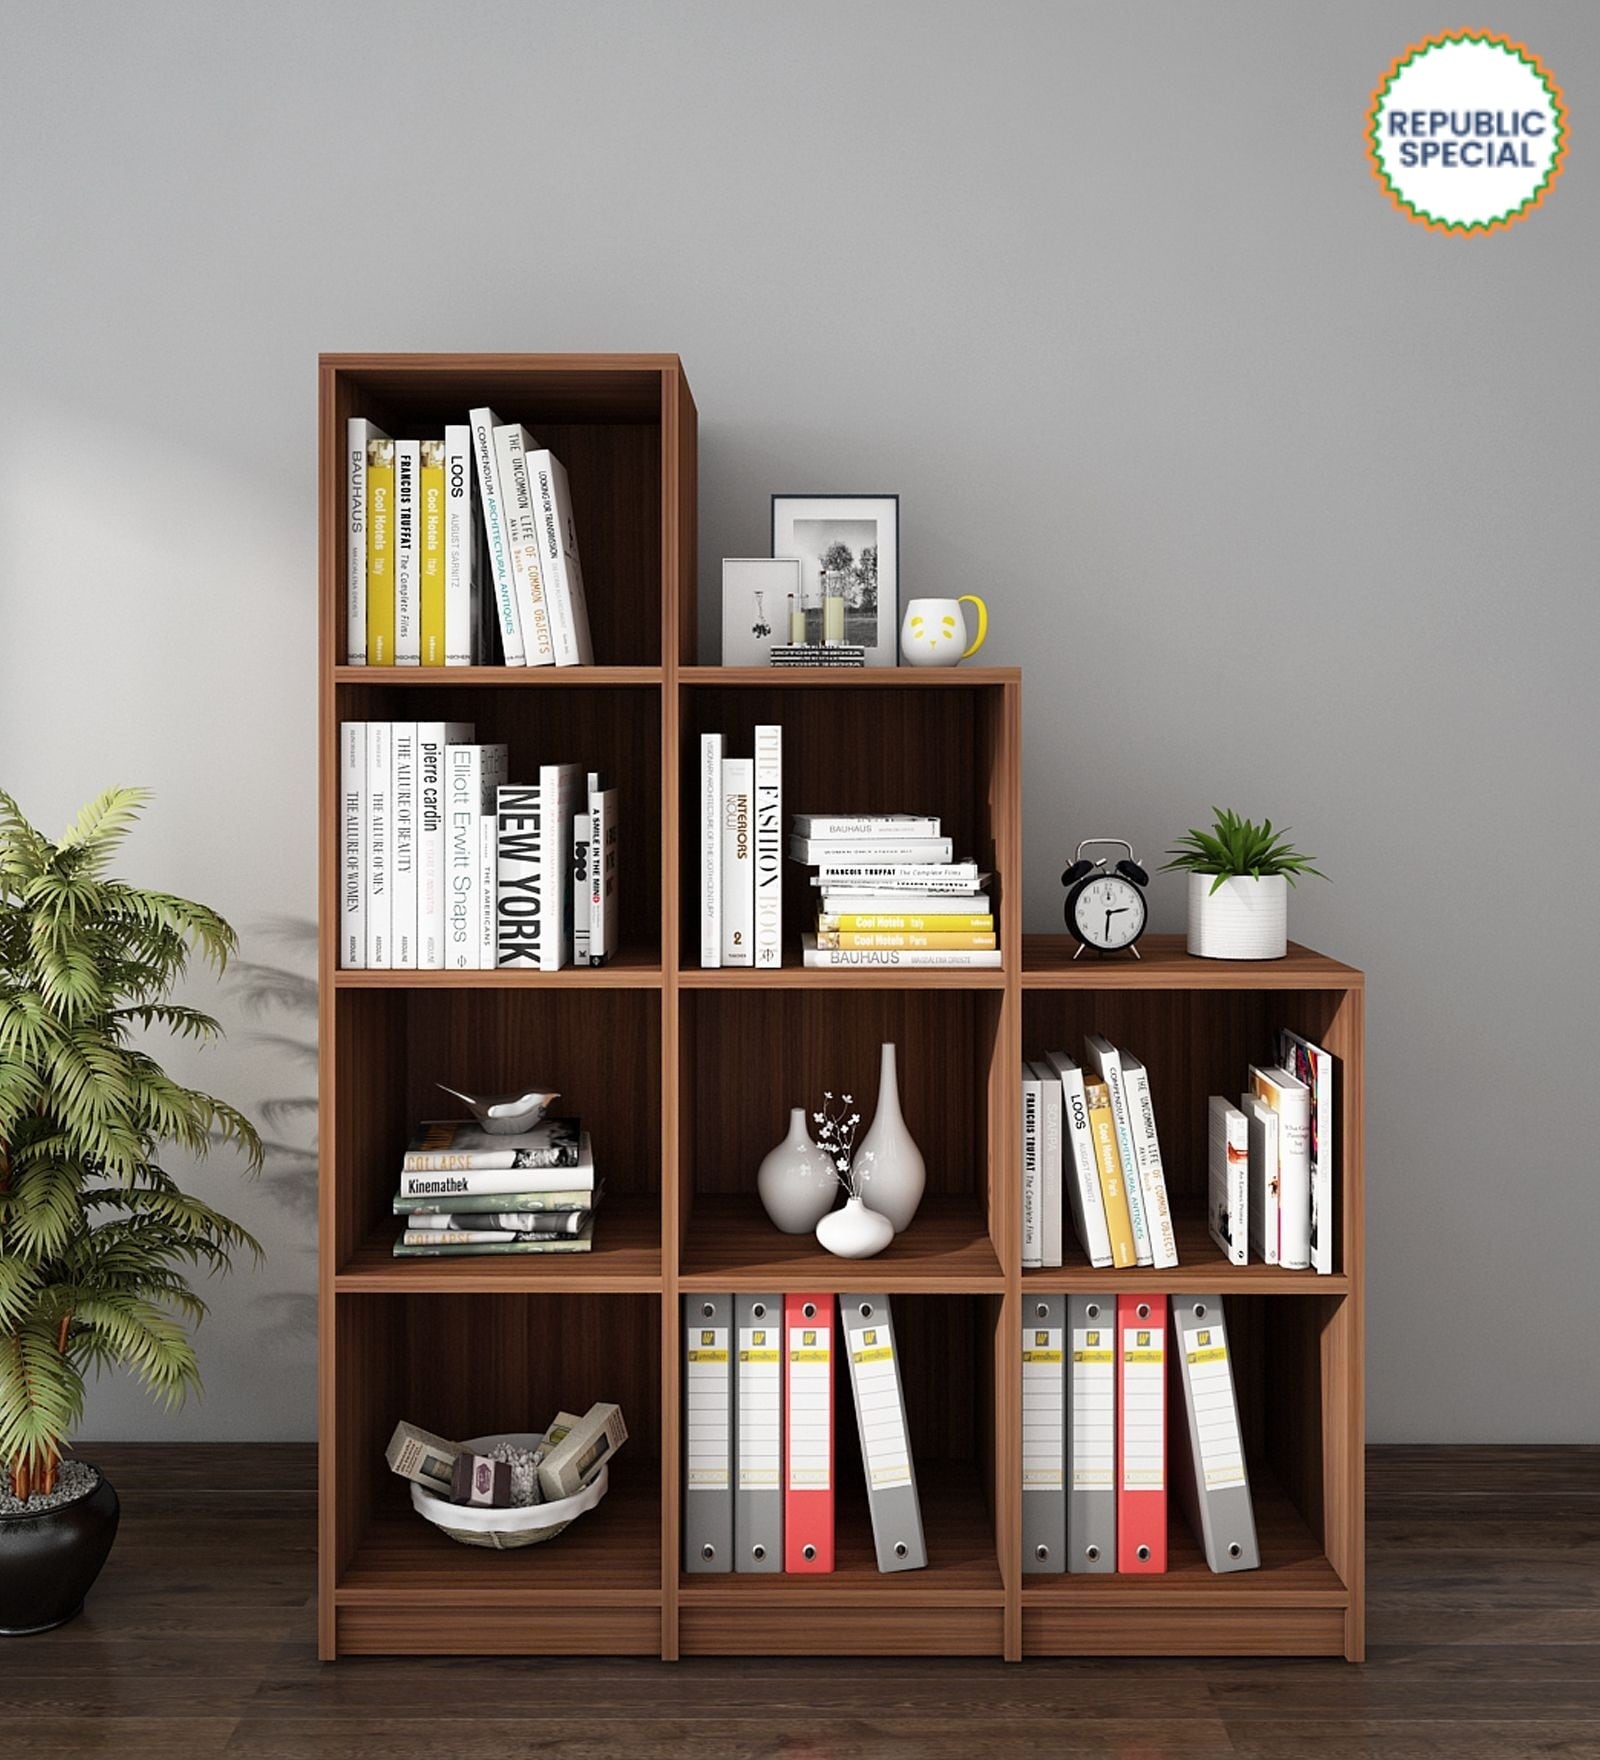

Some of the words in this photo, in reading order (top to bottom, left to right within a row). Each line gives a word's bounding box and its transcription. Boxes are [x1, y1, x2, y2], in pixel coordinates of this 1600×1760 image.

[508, 434, 521, 452] THE
[400, 454, 412, 504] FRANCOIS
[450, 455, 463, 498] LOOS
[512, 458, 528, 509] UNCOMMON
[538, 470, 551, 499] LOOKING
[352, 451, 362, 533] BAUHAUS
[374, 488, 386, 512] Cool
[427, 488, 438, 512] Cool
[542, 500, 552, 512] FOR
[374, 514, 386, 550] Hotels
[400, 508, 412, 550] TRUFFAT
[427, 514, 438, 550] Hotels
[450, 513, 460, 549] AUGUST
[477, 426, 494, 495] COMPENDIUM
[488, 498, 507, 580] ARCHITECTURAL
[500, 584, 515, 635] ANTIQUES
[510, 518, 519, 542] Akiko
[520, 515, 533, 540] LIFE
[373, 558, 385, 576] Italy
[400, 554, 410, 570] The
[426, 558, 438, 576] Italy
[524, 546, 536, 559] OF
[450, 551, 460, 588] SARNITZ
[400, 572, 410, 612] Complete
[528, 565, 541, 604] COMMON
[400, 614, 410, 638] Films
[534, 610, 550, 654] OBJECTS
[398, 736, 411, 760] THE
[759, 729, 778, 778] THE
[421, 743, 442, 783] pierre
[453, 751, 471, 804] Elliott
[398, 762, 411, 807] ALLURE
[347, 792, 358, 812] THE
[373, 792, 384, 812] THE
[424, 788, 442, 832] cardin
[398, 809, 411, 825] OF
[499, 789, 541, 862] NEW
[592, 817, 600, 845] SMILE
[738, 794, 747, 860] INTERIORS
[829, 824, 872, 834] BAUHAUS
[347, 814, 358, 854] ALLURE
[373, 815, 384, 854] ALLURE
[453, 812, 471, 868] Erwitt
[707, 831, 714, 841] OF
[759, 786, 778, 888] FASHION
[347, 856, 358, 870] OF
[373, 856, 384, 870] OF
[398, 827, 411, 874] BEAUTY
[592, 847, 600, 857] IN
[592, 860, 600, 876] THE
[347, 872, 358, 913] WOMEN
[373, 872, 384, 896] MEN
[592, 878, 600, 904] MIND
[450, 876, 472, 943] Snaps
[499, 874, 541, 964] YORK
[856, 918, 874, 928] Cool
[877, 918, 904, 928] Hotels
[734, 932, 742, 945] 2
[854, 935, 873, 945] Cool
[876, 935, 904, 945] Hotels
[909, 936, 928, 945] Paris
[830, 952, 900, 964] BAUHAUS
[1137, 1077, 1148, 1092] THE
[1026, 1092, 1035, 1133] FRANCOIS
[1070, 1095, 1086, 1130] LOOS
[1139, 1098, 1154, 1140] UNCOMMON
[1046, 1104, 1057, 1152] SCARPA
[1098, 1122, 1110, 1143] Cool
[406, 1155, 472, 1171] COLLAPSE
[1026, 1136, 1035, 1172] TRUFFAT
[1080, 1142, 1091, 1172] AUGUST
[1101, 1144, 1115, 1174] Hotels
[1109, 1067, 1125, 1125] COMPENDIUM
[1119, 1126, 1136, 1195] ARCHITECTURAL
[1131, 1197, 1144, 1240] ANTIQUES
[1147, 1144, 1159, 1164] LIFE
[408, 1177, 468, 1194] Kinemathek
[1026, 1175, 1034, 1188] The
[1108, 1178, 1118, 1197] Paris
[1150, 1169, 1161, 1180] OF
[1024, 1190, 1033, 1224] Complete
[1154, 1185, 1166, 1217] COMMON
[406, 1233, 472, 1244] COLLAPSE
[1026, 1225, 1034, 1244] Films
[1161, 1222, 1175, 1258] OBJECTS
